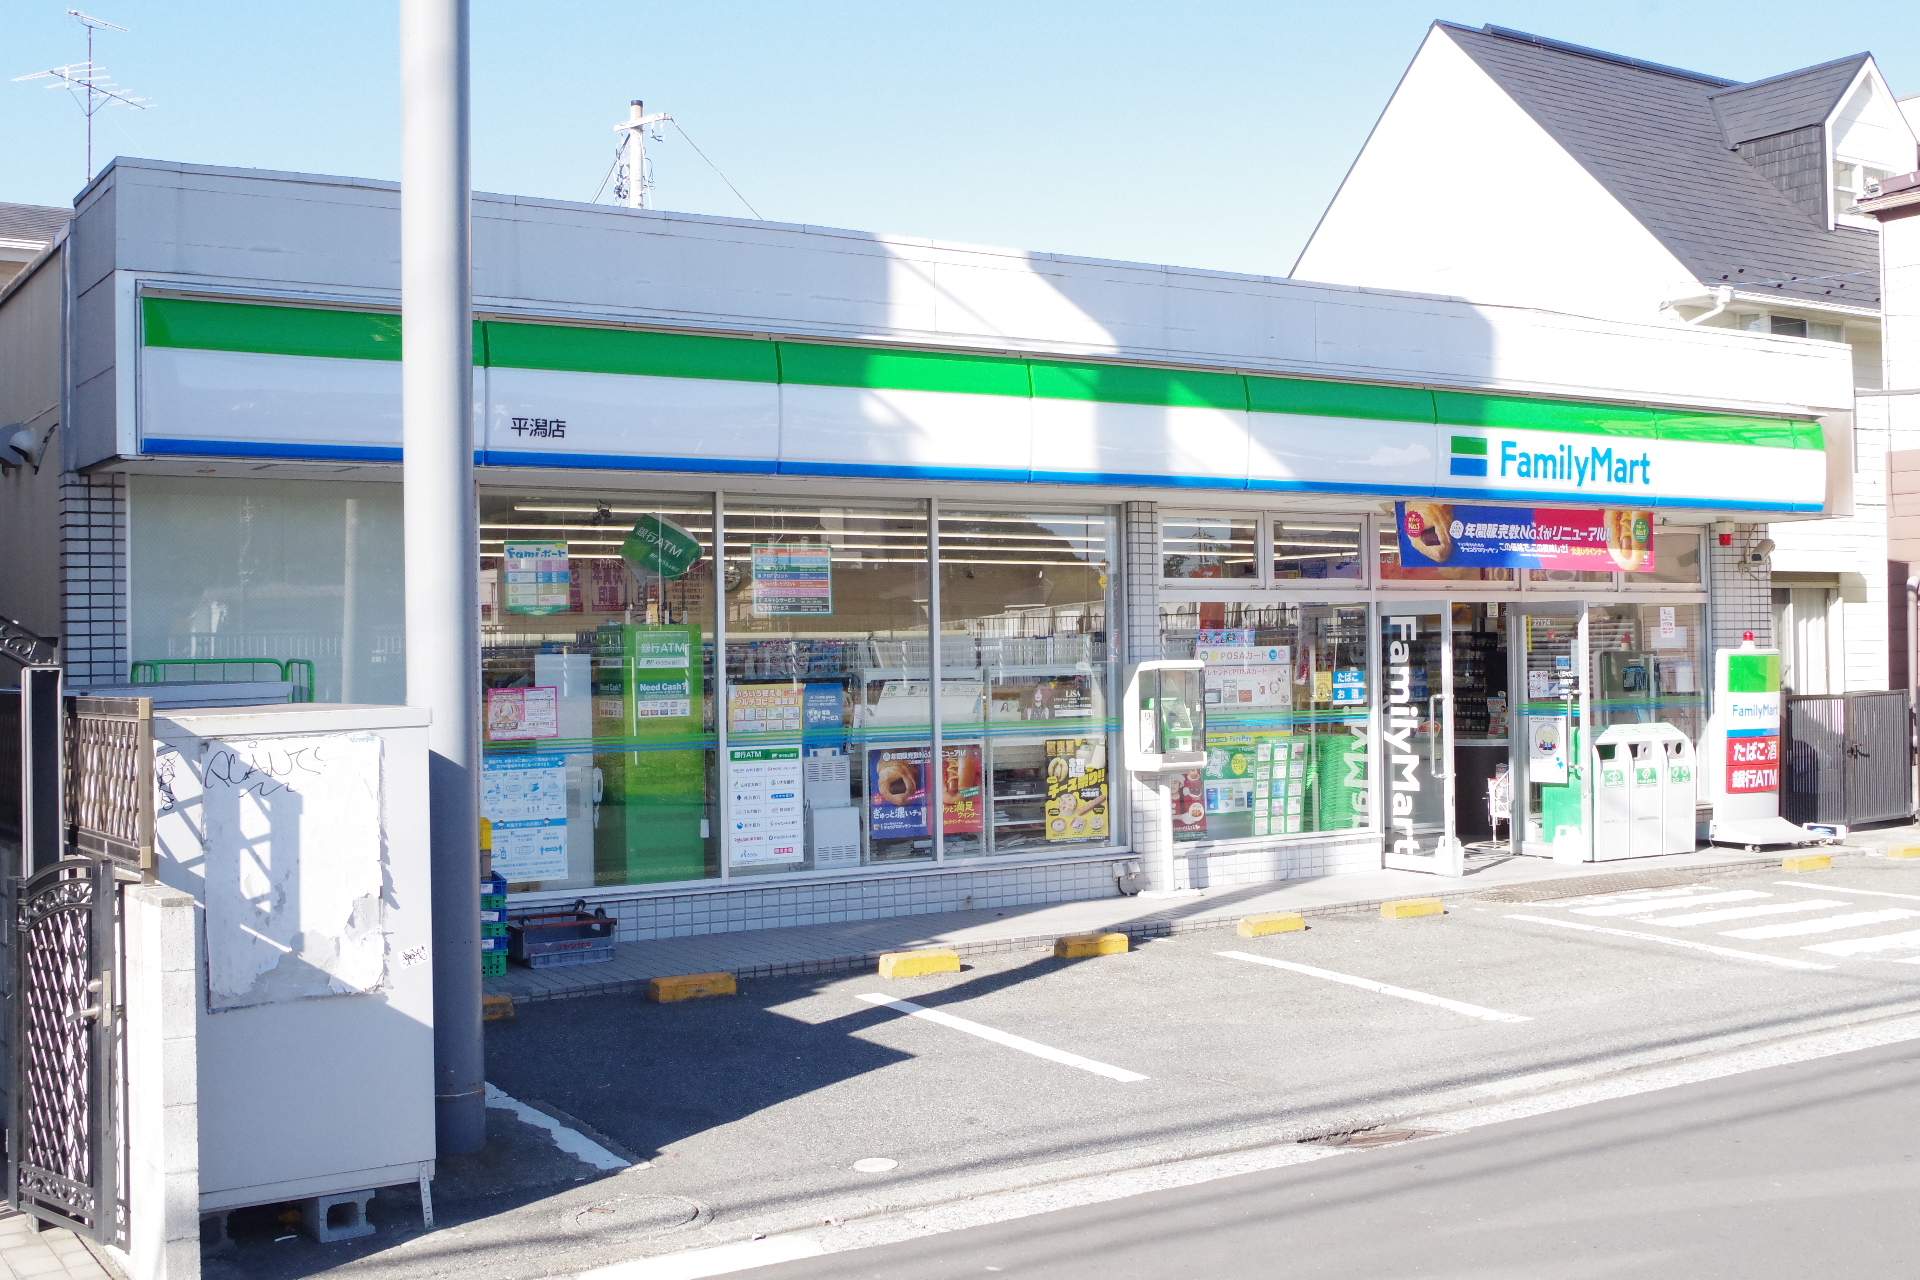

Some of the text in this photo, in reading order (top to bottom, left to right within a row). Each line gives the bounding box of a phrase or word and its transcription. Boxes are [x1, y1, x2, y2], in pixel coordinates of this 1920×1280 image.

[511, 417, 566, 438] 平潟店
[1500, 441, 1650, 487] FamilyMart
[637, 526, 683, 557] 銀行ATM
[640, 682, 661, 691] Need
[1337, 672, 1359, 683] たばこ
[1732, 704, 1778, 719] FamilyMart
[1383, 616, 1421, 855] FamilyMart
[1733, 740, 1777, 761] たばこ・酒
[1731, 768, 1777, 788] 銀行ATM
